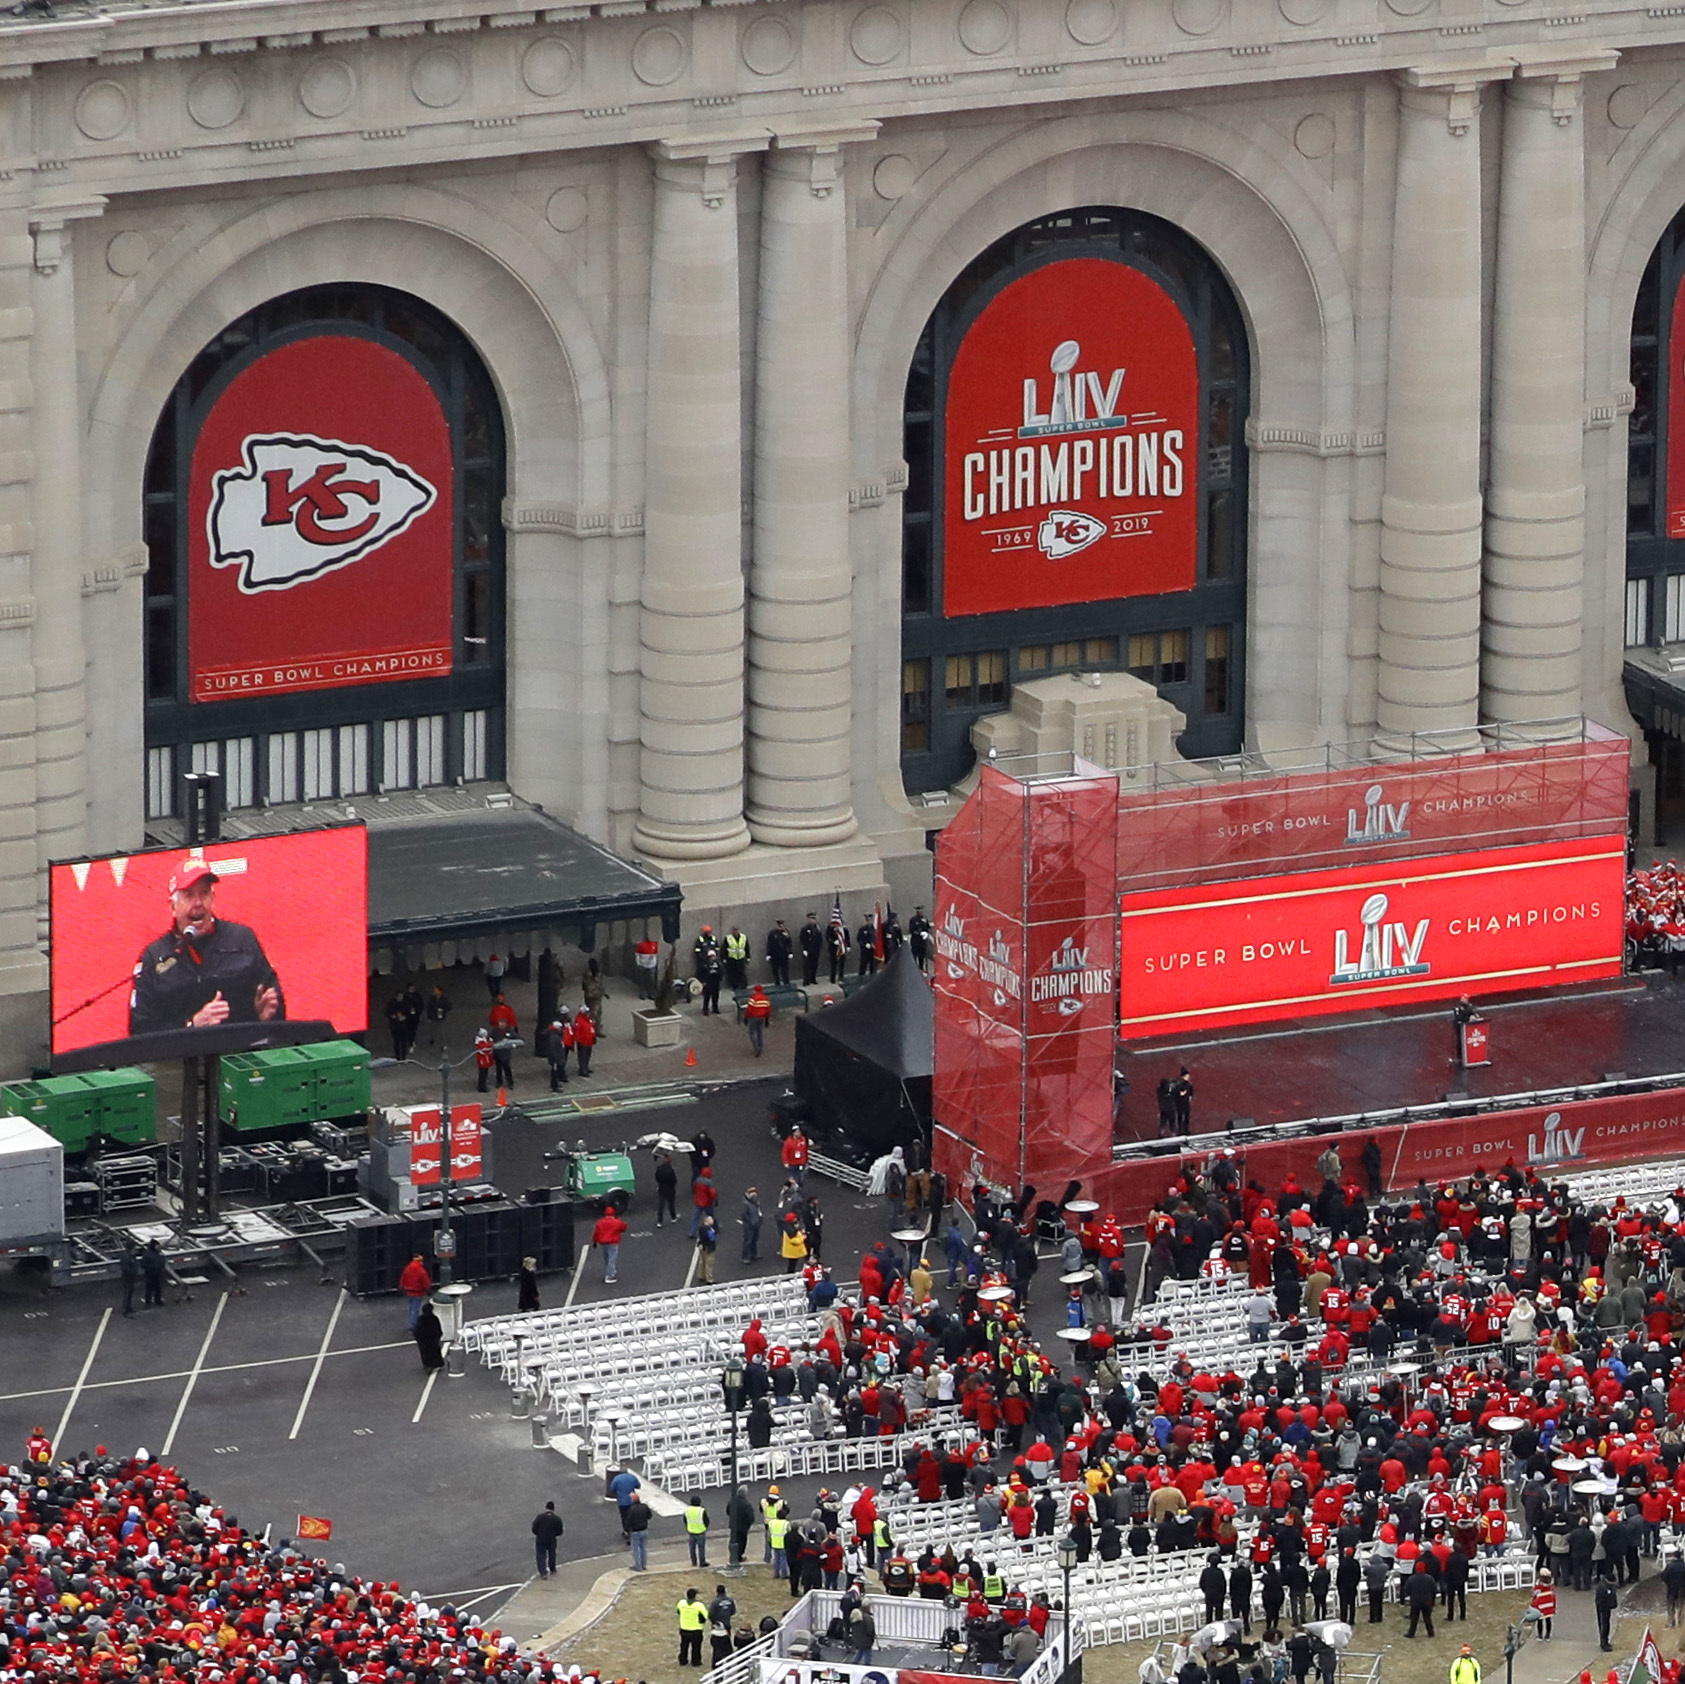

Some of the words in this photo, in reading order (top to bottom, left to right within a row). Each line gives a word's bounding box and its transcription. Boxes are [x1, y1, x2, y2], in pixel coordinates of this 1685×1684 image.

[1038, 424, 1073, 434] SUPER
[1077, 420, 1106, 430] BOWL
[964, 430, 1183, 521] CHAMPIONS
[261, 462, 380, 545] KC
[996, 532, 1031, 546] 1969
[1113, 518, 1149, 532] 2019
[204, 674, 264, 690] SUPER
[274, 668, 323, 683] BOWL
[334, 653, 443, 677] CHAMPIONS
[1217, 821, 1275, 839] SUPER
[1284, 816, 1331, 831] BOWL
[1423, 790, 1529, 814] CHAMPIONS
[1144, 949, 1226, 974] SUPER
[1243, 938, 1311, 963] BOWL
[1449, 902, 1601, 935] CHAMPIONS
[1031, 969, 1112, 1001] CHAMPIONS
[1348, 971, 1380, 982] SUPER
[1384, 967, 1411, 979] BOWL
[1415, 1146, 1464, 1161] SUPER
[1473, 1139, 1514, 1154] BOWL
